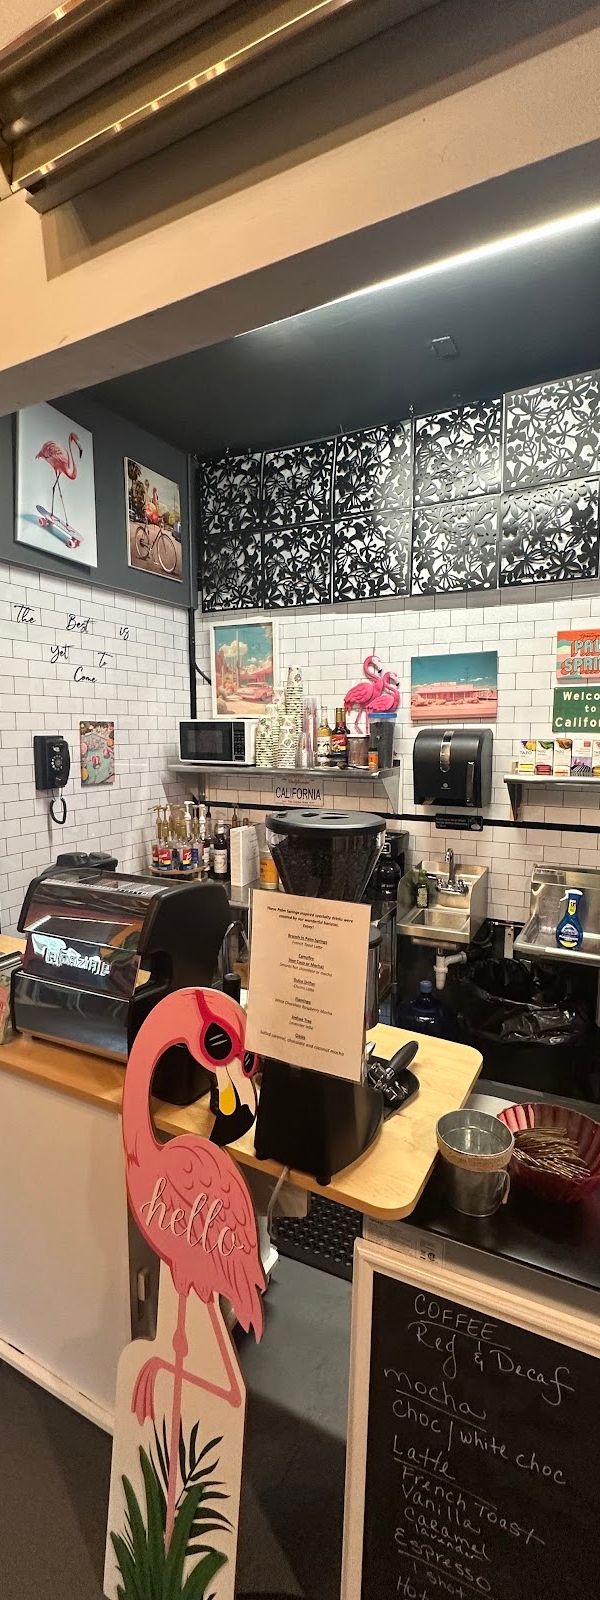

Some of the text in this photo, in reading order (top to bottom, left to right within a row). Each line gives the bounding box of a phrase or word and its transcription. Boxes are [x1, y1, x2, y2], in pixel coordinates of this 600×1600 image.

[14, 604, 36, 623] The
[66, 613, 97, 634] Best
[73, 666, 97, 683] Come
[562, 656, 600, 675] SPRI
[555, 716, 600, 727] Califo
[584, 704, 597, 713] to
[275, 786, 321, 801] CALIFORNIA
[140, 1177, 244, 1256] hello
[414, 1293, 498, 1340] COFFEE
[408, 1321, 457, 1379] Reg
[489, 1350, 575, 1406] Decaf
[393, 1434, 456, 1480] Latte
[402, 1465, 545, 1545] French Toast
[402, 1483, 480, 1534] Vanilla
[395, 1527, 491, 1592] Espresso
